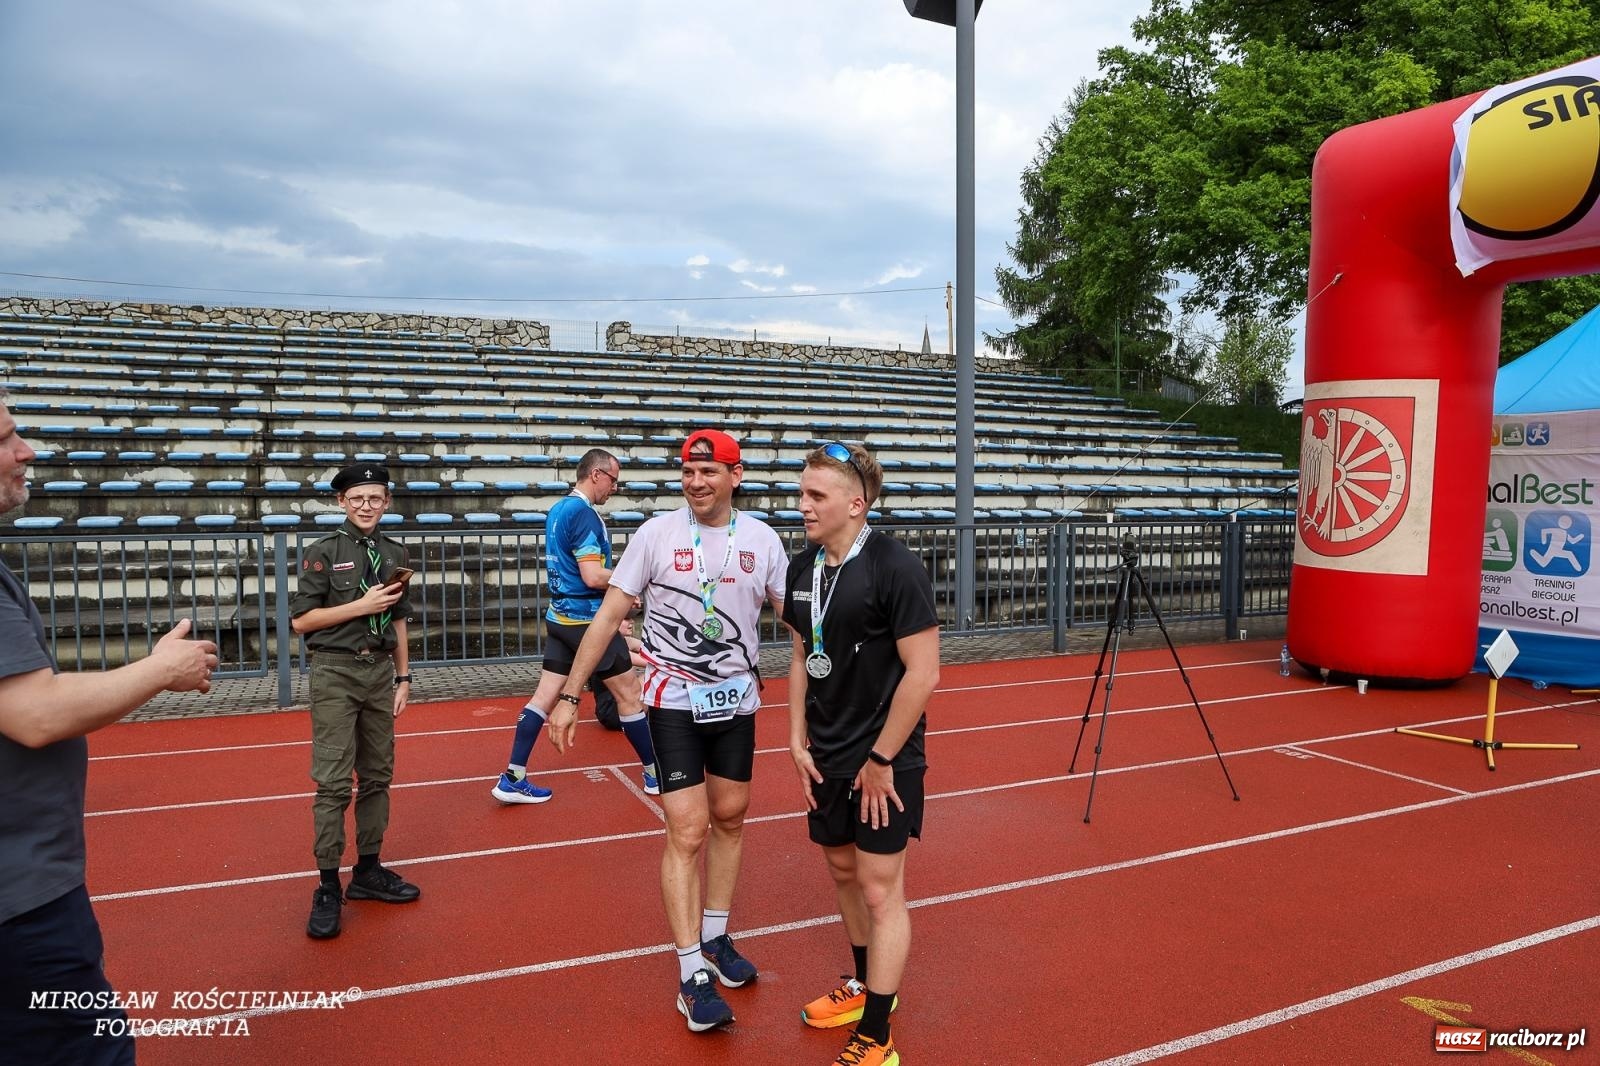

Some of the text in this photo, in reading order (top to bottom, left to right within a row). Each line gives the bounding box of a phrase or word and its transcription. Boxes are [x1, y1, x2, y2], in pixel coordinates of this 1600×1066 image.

[1488, 473, 1594, 505] alBest
[1534, 578, 1575, 590] TRENINGI
[1531, 590, 1576, 602] BIEGOWE
[705, 688, 740, 708] 198
